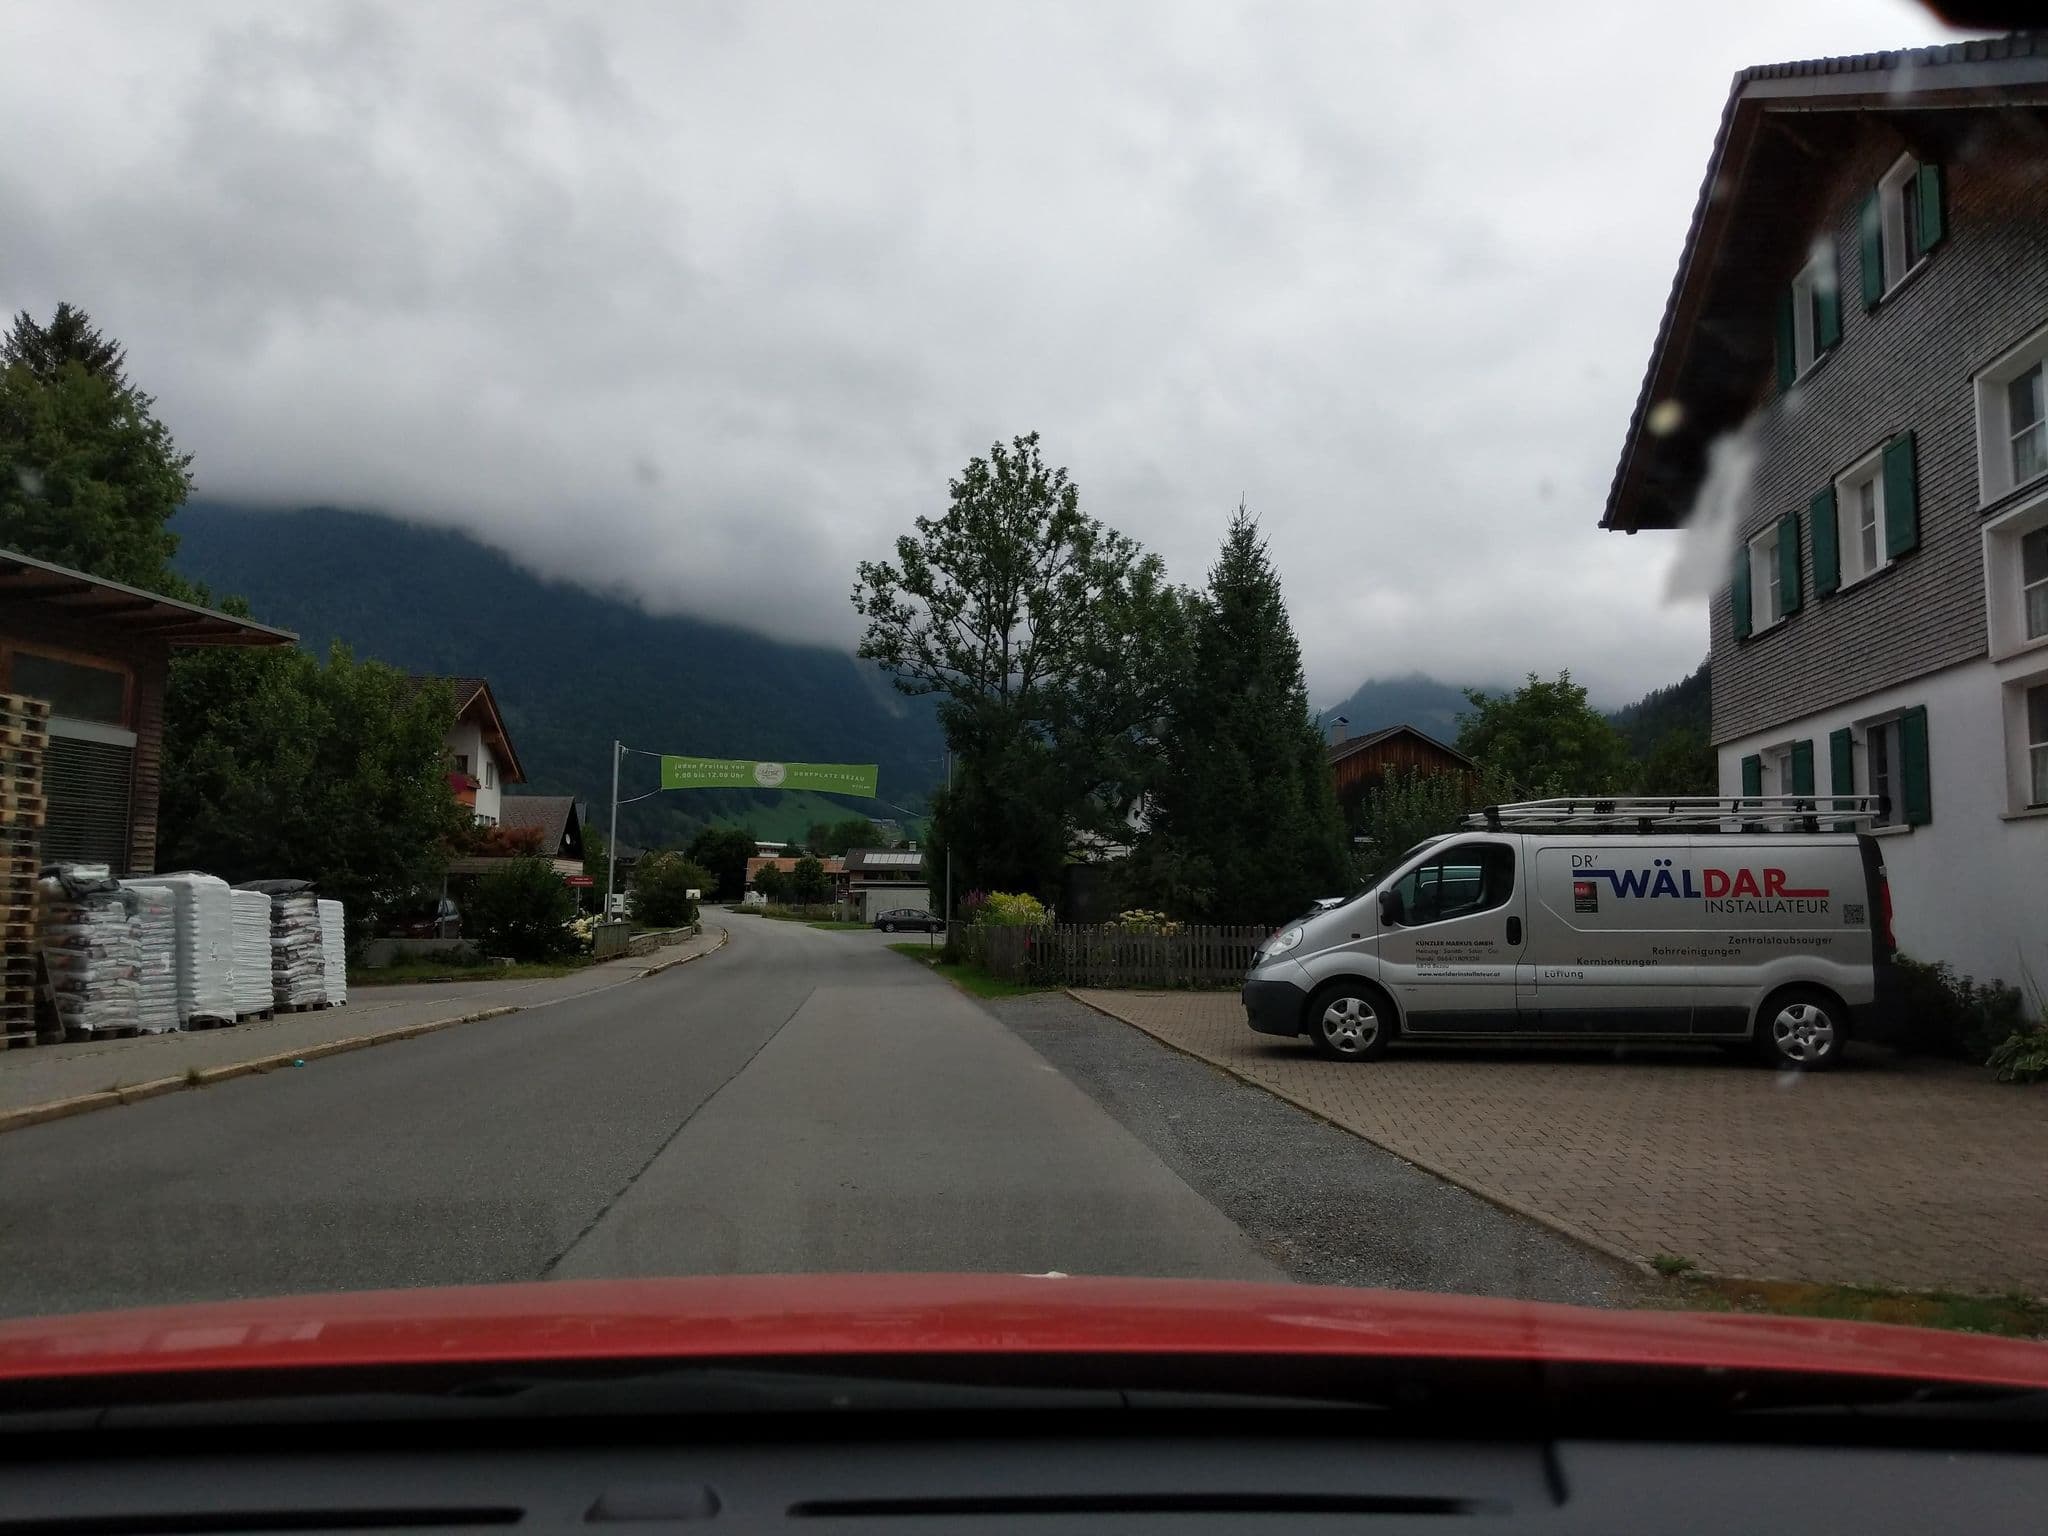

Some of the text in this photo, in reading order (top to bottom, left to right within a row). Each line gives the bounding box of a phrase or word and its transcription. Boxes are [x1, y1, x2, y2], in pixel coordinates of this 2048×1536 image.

[699, 763, 728, 771] Freitag
[1573, 859, 1830, 898] WÄLDAR
[1705, 899, 1829, 914] INSTALLATEUR
[1728, 936, 1833, 947] Zentralstaubsauger
[1652, 947, 1741, 957] Rohrreinigungen
[1576, 957, 1658, 967] Kernbohrungen
[1544, 970, 1584, 980] Lüftung
